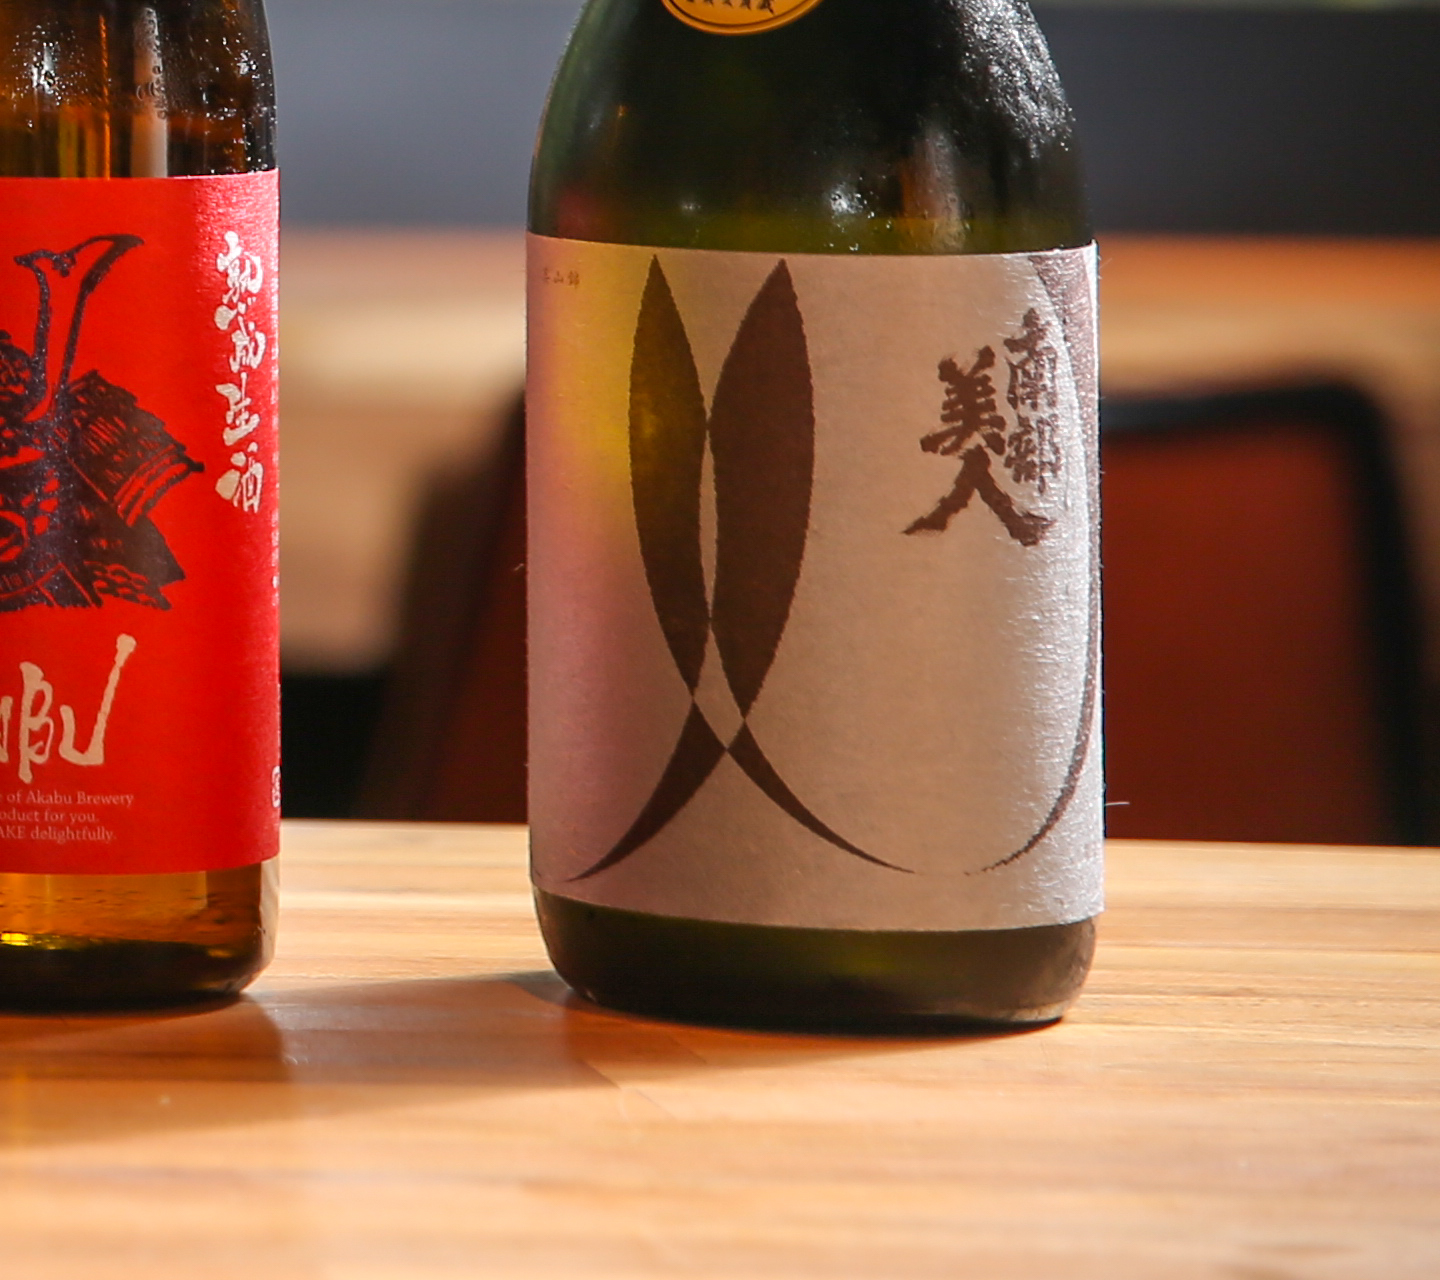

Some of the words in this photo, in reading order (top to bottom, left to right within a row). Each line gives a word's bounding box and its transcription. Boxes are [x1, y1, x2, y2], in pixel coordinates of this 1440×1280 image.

[6, 790, 23, 804] of
[26, 790, 73, 805] Akabu
[77, 792, 135, 808] Brewery
[44, 809, 66, 823] for
